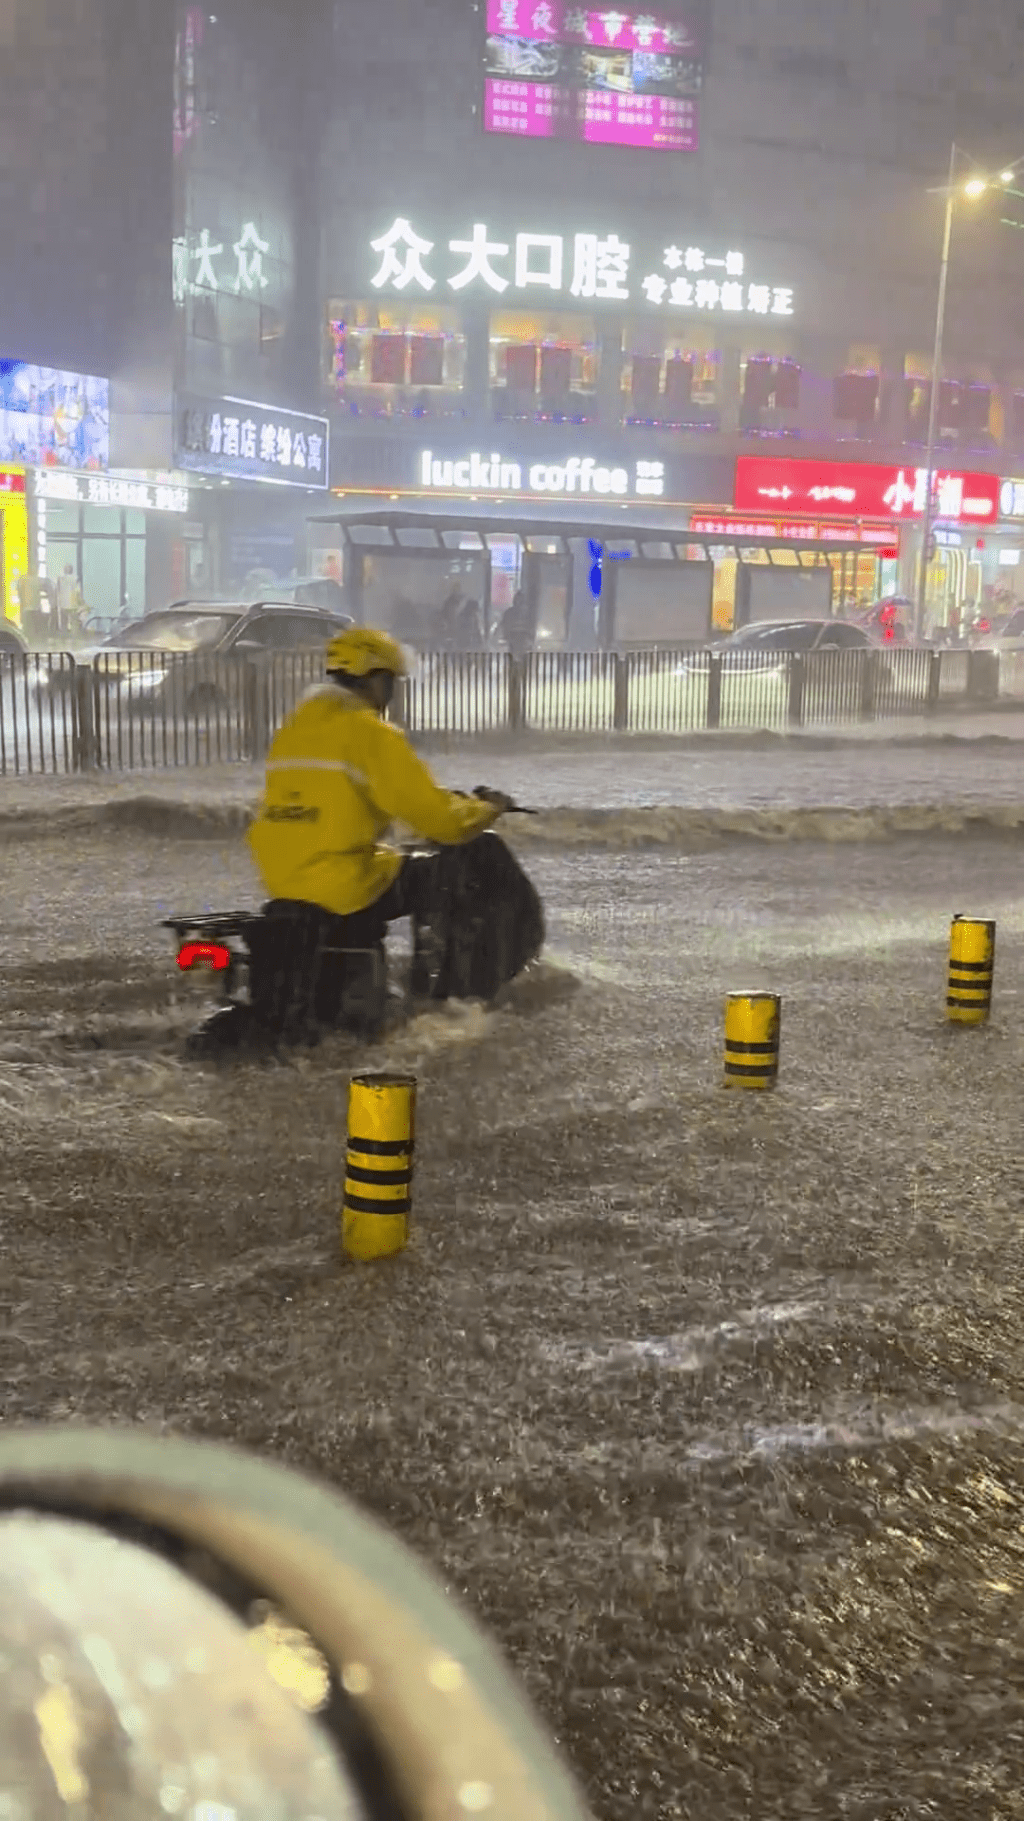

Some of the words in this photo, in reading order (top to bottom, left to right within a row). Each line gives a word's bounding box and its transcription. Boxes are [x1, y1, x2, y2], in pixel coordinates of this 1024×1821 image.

[369, 216, 630, 299] 众大口腔
[421, 450, 522, 490] luckin
[529, 456, 629, 495] coffee
